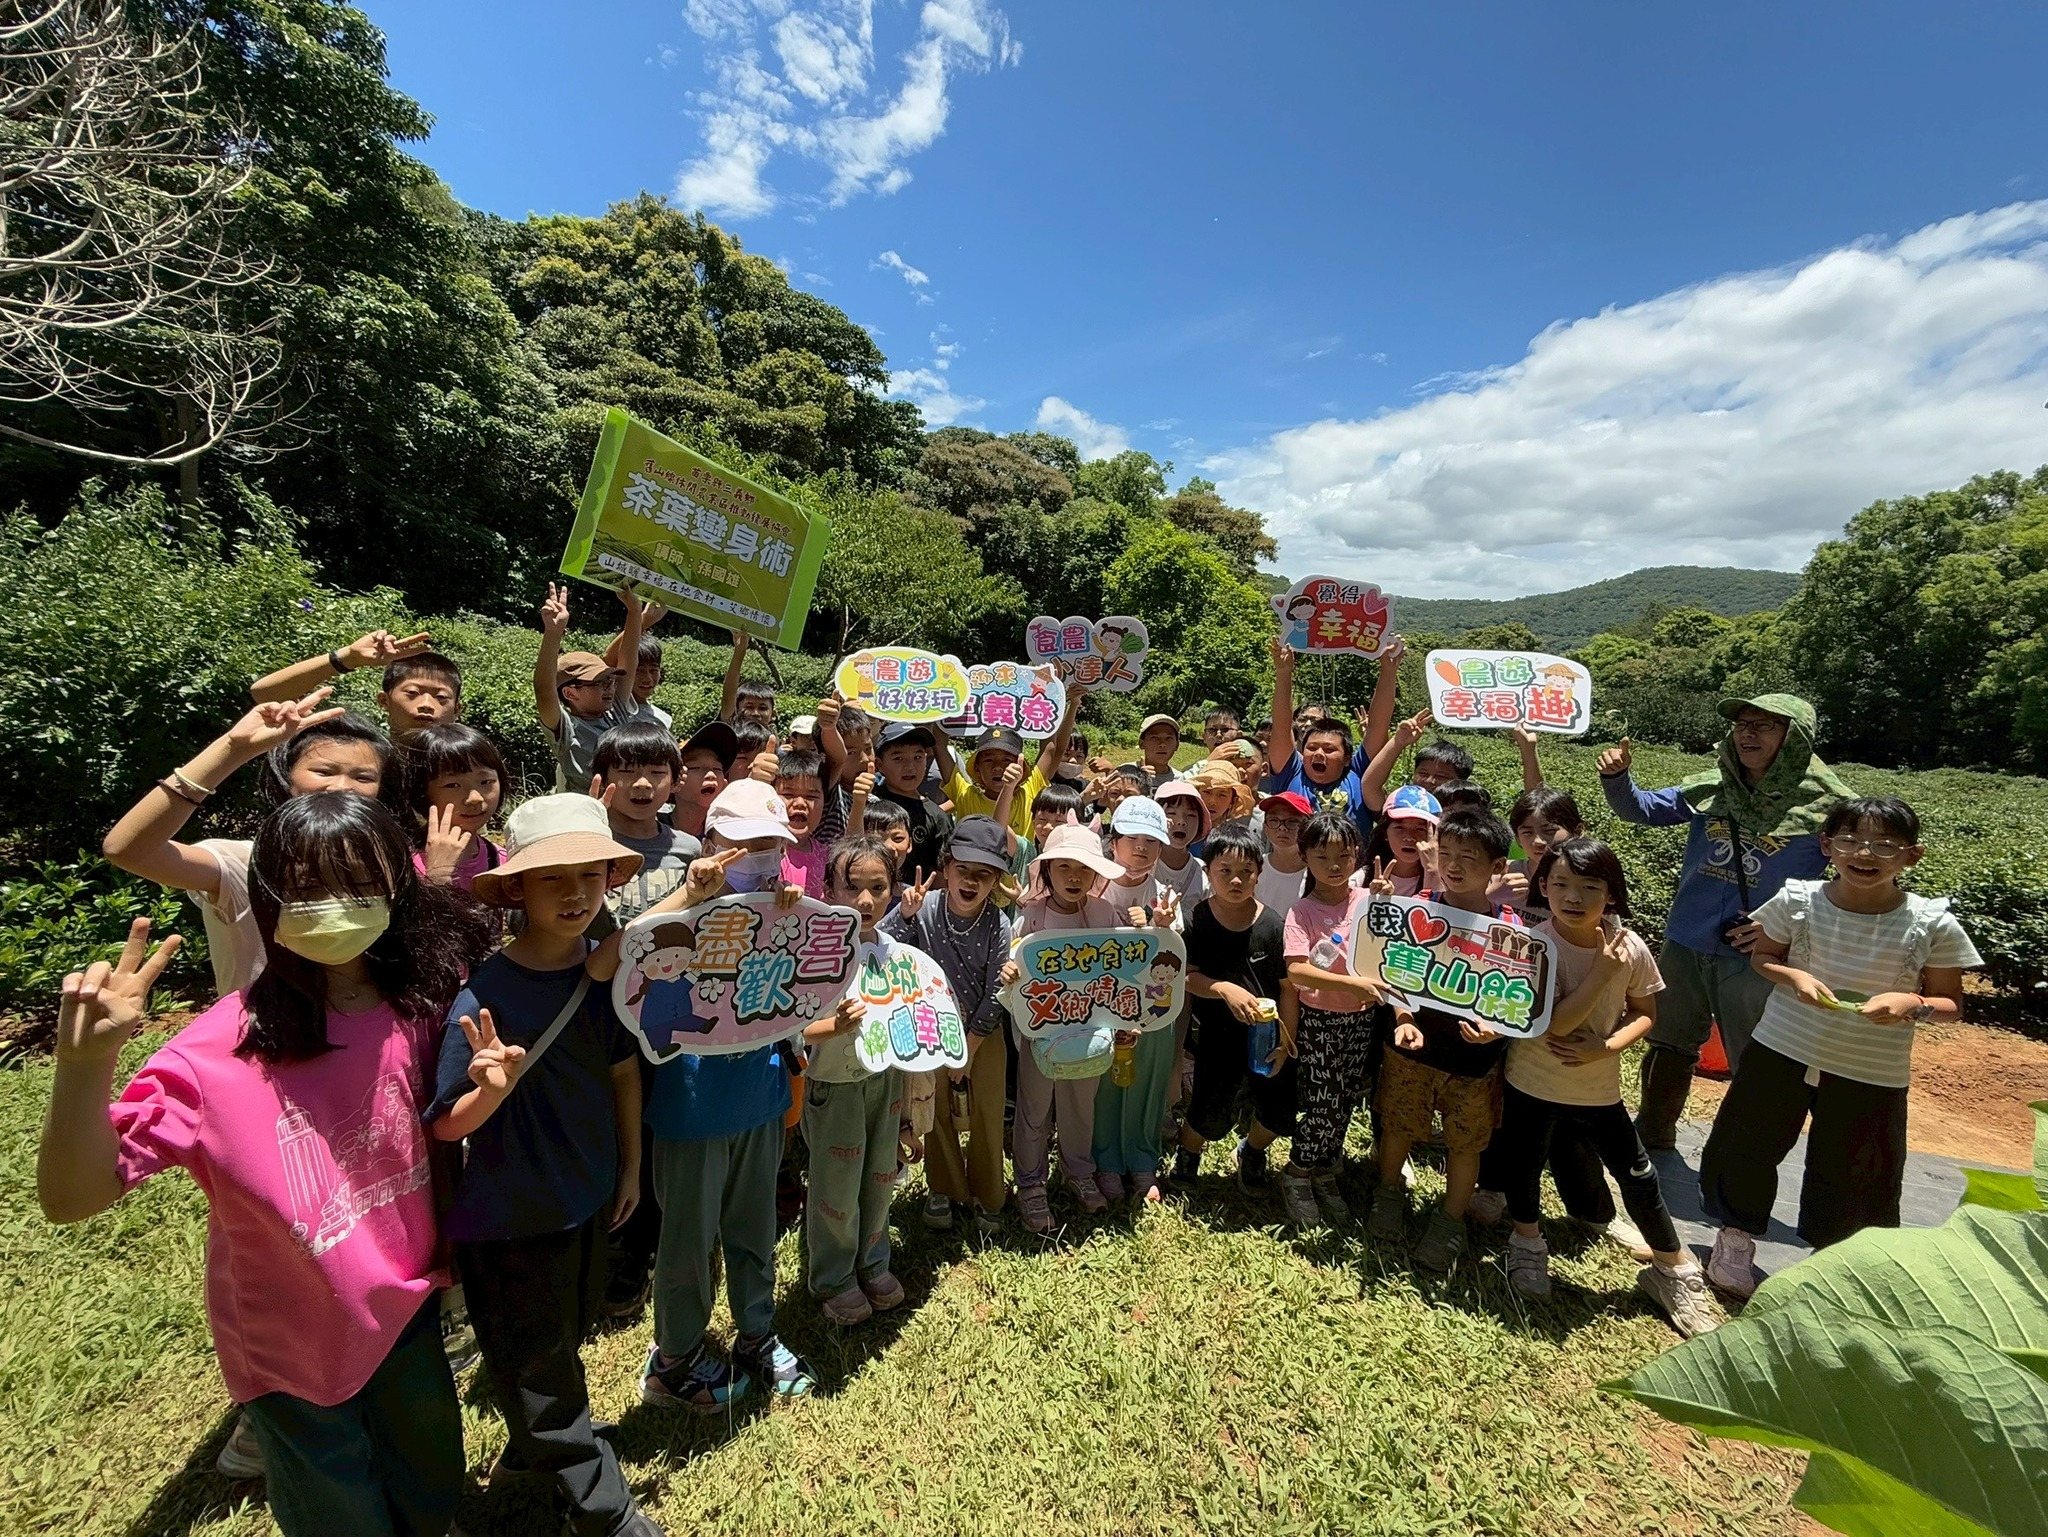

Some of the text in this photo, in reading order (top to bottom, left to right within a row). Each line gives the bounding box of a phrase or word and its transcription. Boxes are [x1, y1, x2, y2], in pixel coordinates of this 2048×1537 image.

[622, 472, 794, 578] 茶葉變身術
[1317, 584, 1360, 604] 覺得
[1029, 622, 1088, 654] 食農
[1318, 608, 1380, 650] 幸福
[874, 657, 934, 684] 農遊
[1050, 655, 1137, 684] 小達人
[1458, 657, 1535, 687] 農遊
[877, 688, 957, 711] 好好玩
[1441, 684, 1578, 727] 幸福趣
[1369, 903, 1402, 936] 我
[1037, 940, 1149, 974] 在地食材
[860, 952, 921, 1002] 山城
[1380, 940, 1535, 1029] 舊山線
[1021, 975, 1142, 1029] 艾鄉情懷
[889, 1002, 963, 1059] 曬幸福
